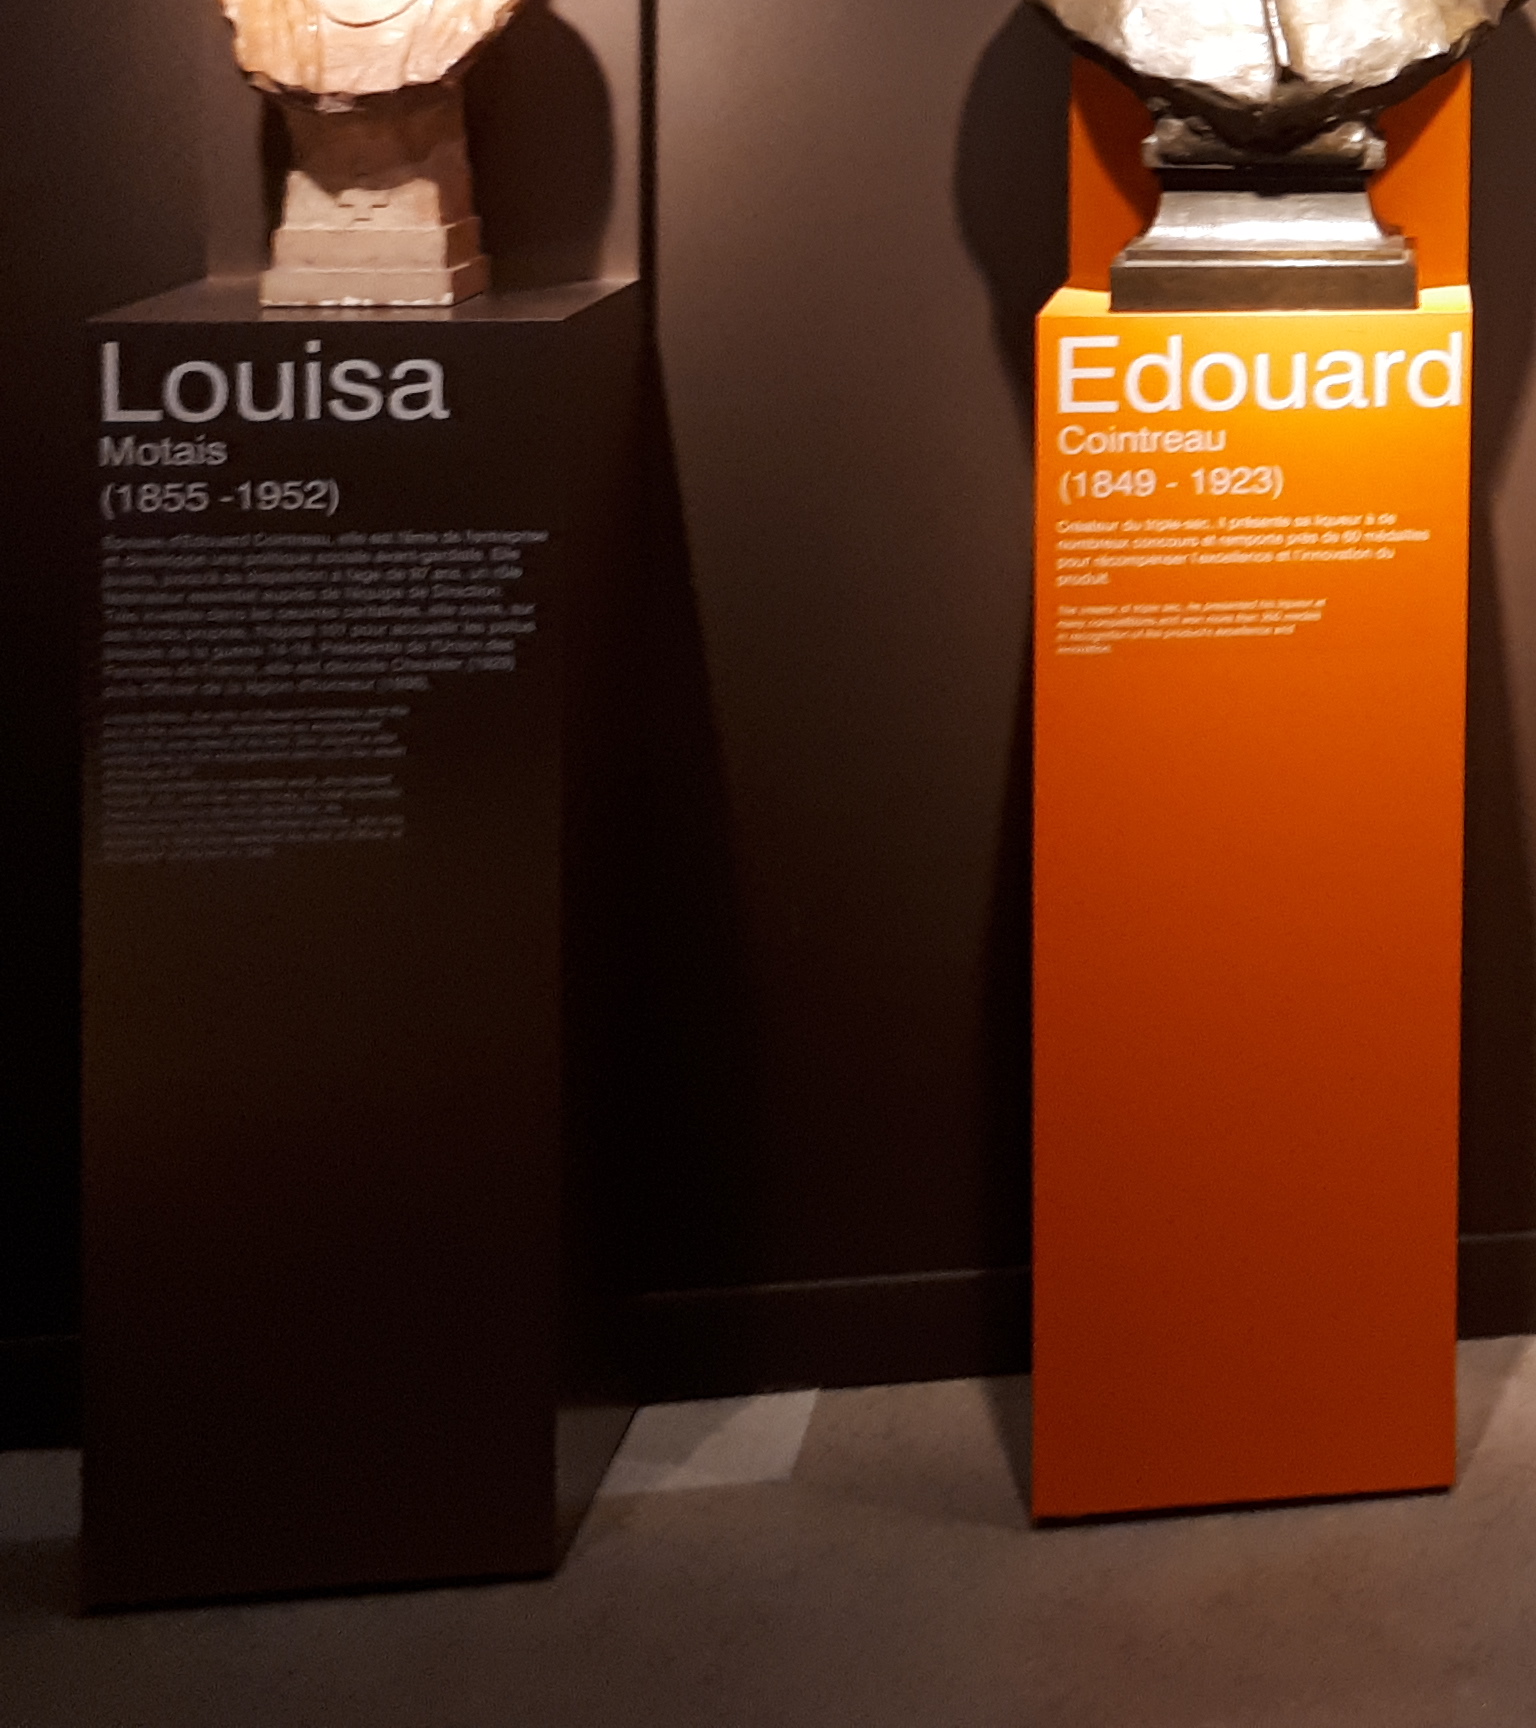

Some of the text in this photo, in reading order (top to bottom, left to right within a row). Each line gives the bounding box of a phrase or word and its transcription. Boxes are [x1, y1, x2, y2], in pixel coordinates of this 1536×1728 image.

[103, 340, 450, 422] Louisa
[1059, 331, 1464, 413] Edouard
[100, 435, 227, 466] Motais
[1059, 425, 1226, 454] Cointreau
[102, 483, 208, 519] (1855
[1060, 469, 1156, 504] (1849
[1192, 466, 1284, 499] 1923)
